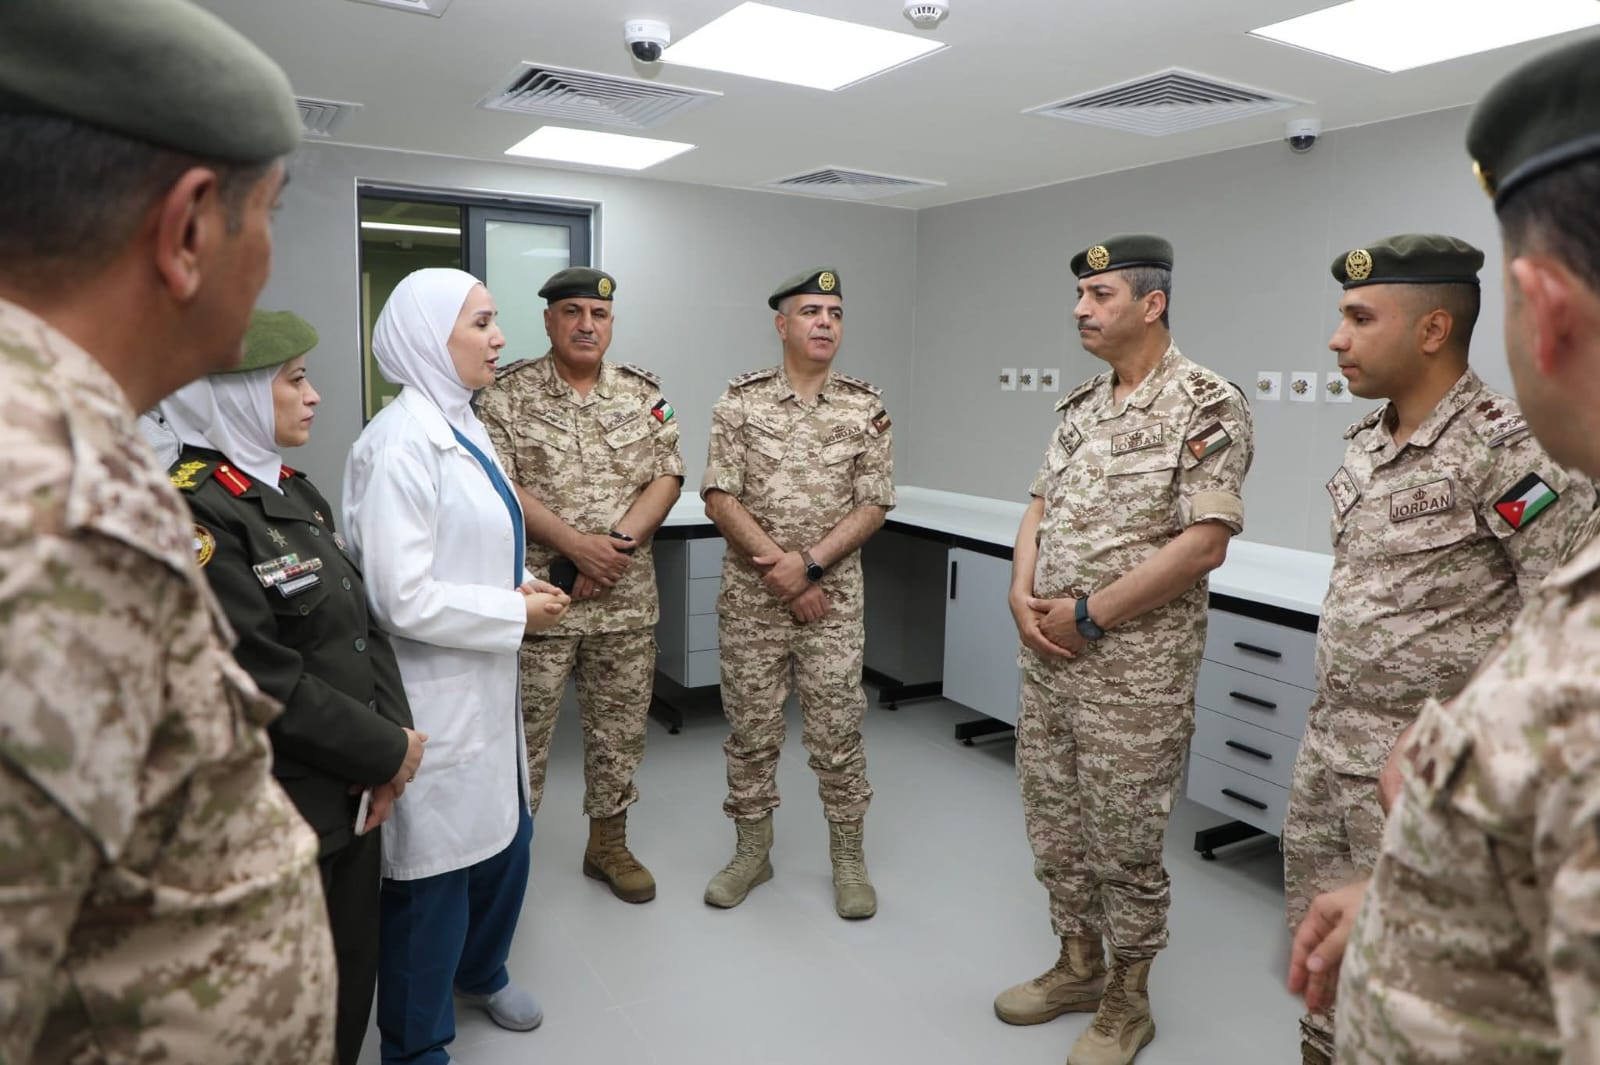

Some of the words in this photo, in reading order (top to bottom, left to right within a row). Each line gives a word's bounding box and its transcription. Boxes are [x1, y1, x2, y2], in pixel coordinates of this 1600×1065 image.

[823, 425, 861, 443] JORDAN
[1112, 433, 1161, 452] JORDAN
[1392, 495, 1449, 518] JORDAN
